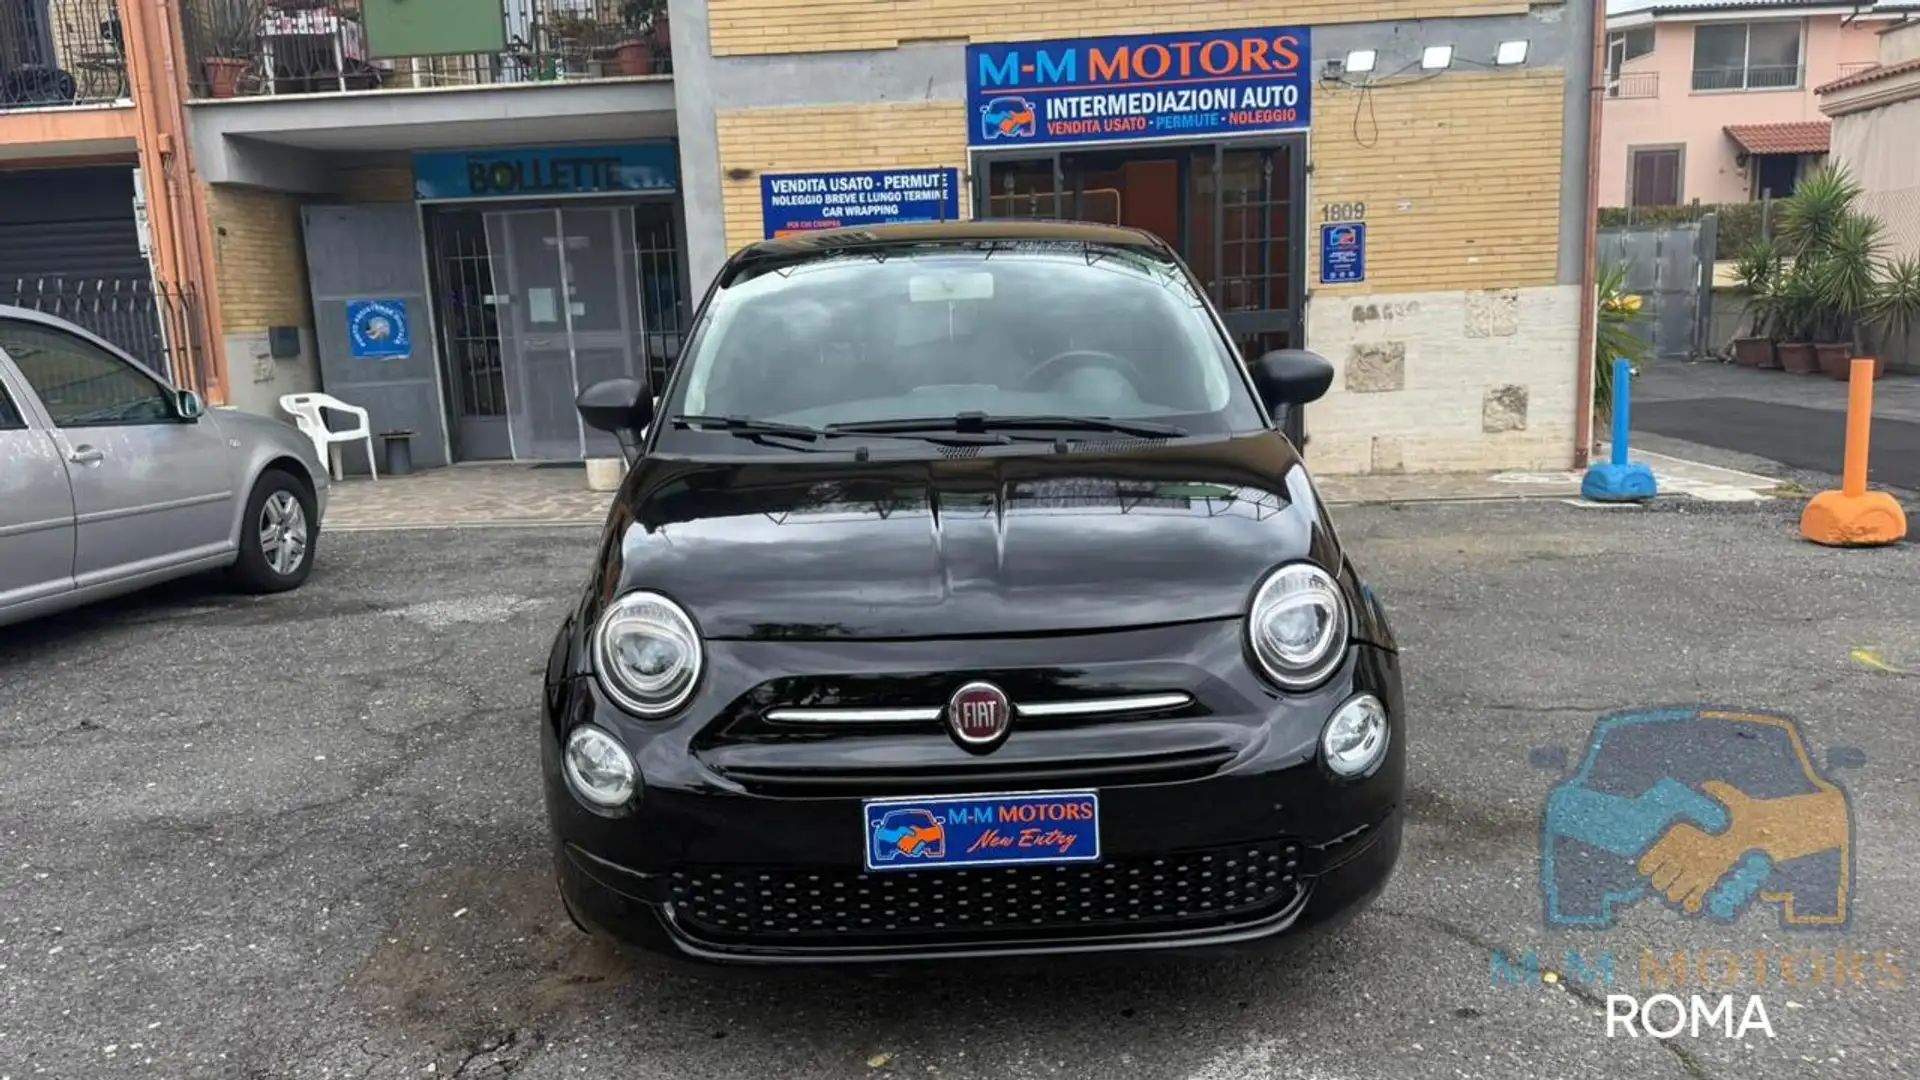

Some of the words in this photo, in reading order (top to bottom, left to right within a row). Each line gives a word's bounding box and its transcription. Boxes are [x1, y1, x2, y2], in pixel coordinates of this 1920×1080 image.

[979, 48, 1076, 86] M-M
[1088, 35, 1299, 82] MOTORS
[1046, 88, 1236, 119] INTERMEDIAZIONI
[1242, 85, 1298, 108] AUTO
[1046, 119, 1101, 136] VENDITA
[1104, 116, 1146, 131] USATO
[1156, 112, 1219, 130] PERMUTE
[1228, 108, 1296, 125] NOLEGGIO
[468, 156, 621, 193] BOLLETTE
[771, 178, 827, 193] VENDITA
[830, 175, 873, 191] USATO
[772, 195, 823, 206] NOLEGGIO
[825, 193, 857, 204] BREVE
[859, 192, 865, 203] E
[868, 191, 901, 202] LUNGO
[822, 206, 843, 217] CAR
[845, 203, 899, 216] WRAPPING
[1321, 202, 1365, 221] 1809
[963, 701, 997, 729] FIAT
[948, 806, 992, 825] M-M
[998, 802, 1092, 823] MOTORS
[967, 829, 1015, 853] New
[1019, 828, 1078, 853] Entry
